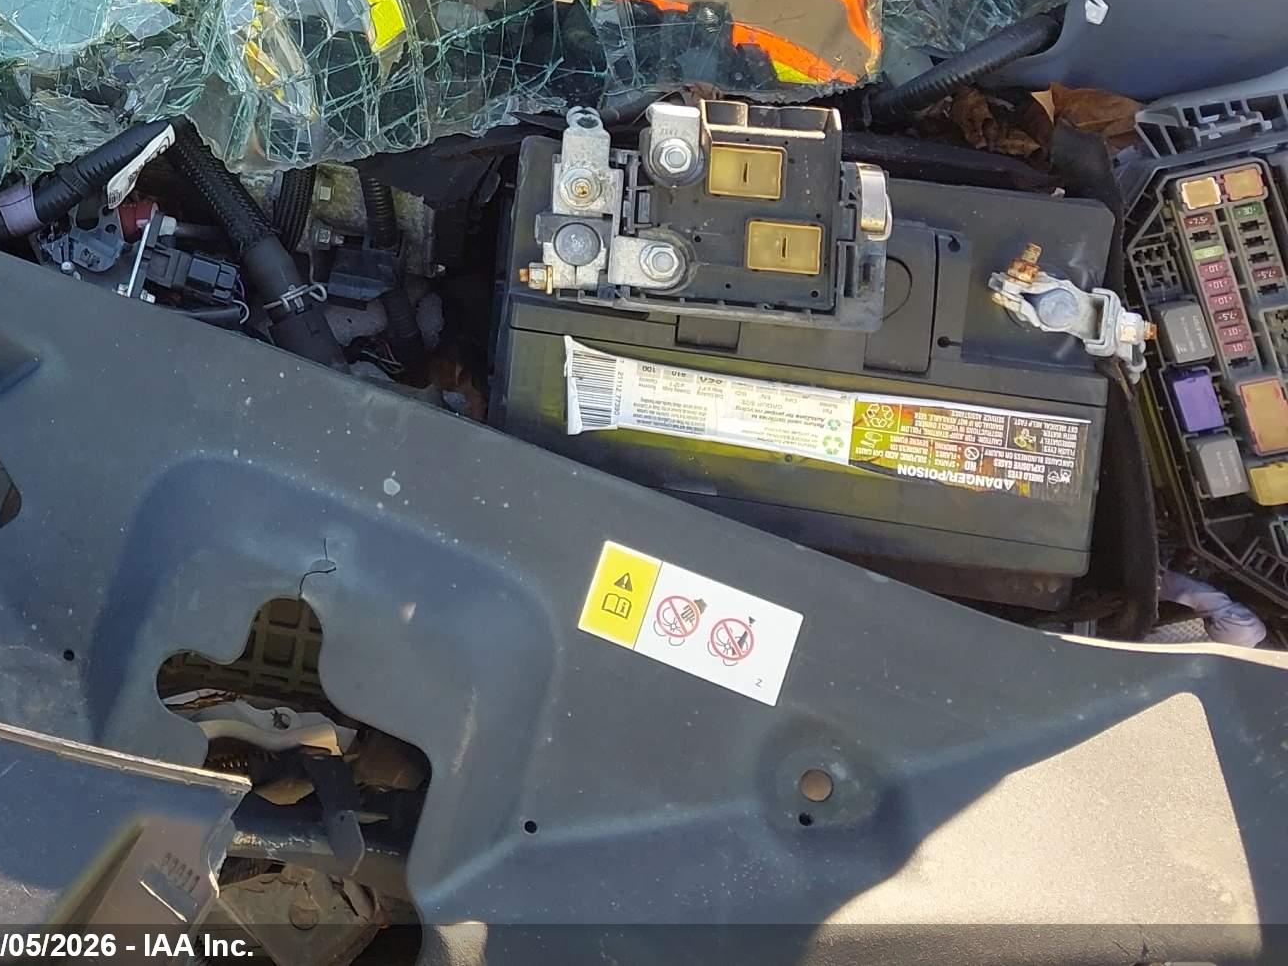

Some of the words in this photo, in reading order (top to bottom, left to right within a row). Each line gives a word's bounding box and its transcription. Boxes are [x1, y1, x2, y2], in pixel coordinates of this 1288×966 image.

[992, 458, 1012, 468] GASES
[1013, 452, 1043, 463] BLINDNESS
[963, 460, 977, 471] NO
[1013, 461, 1045, 472] EXPLOSIVE
[896, 463, 1003, 489] DANGER/POISON
